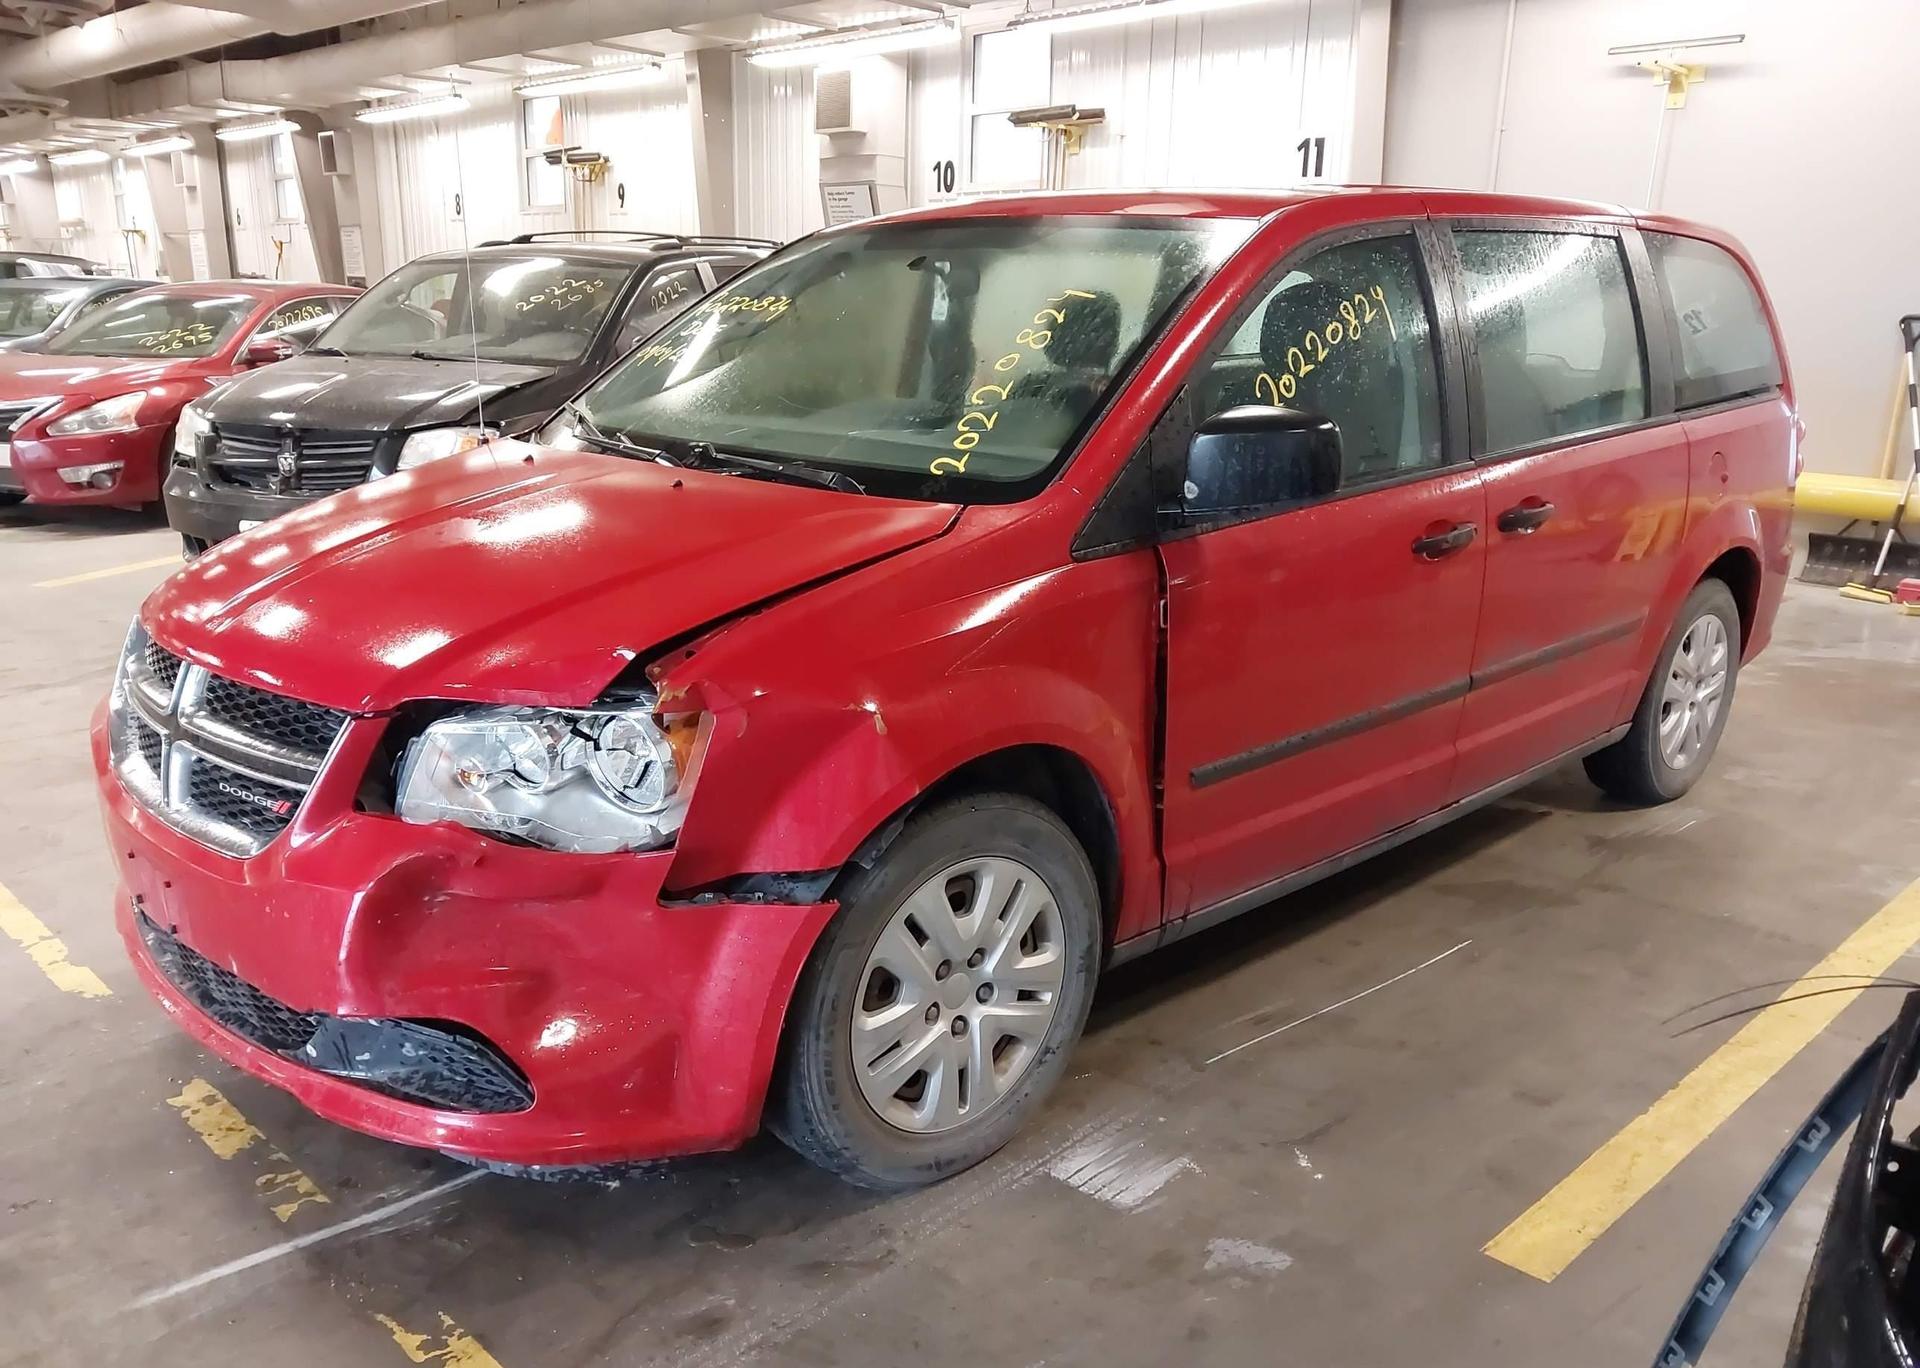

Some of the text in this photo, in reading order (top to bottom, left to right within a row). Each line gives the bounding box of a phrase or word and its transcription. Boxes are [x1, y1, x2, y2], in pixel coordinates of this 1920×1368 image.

[1297, 137, 1325, 177] 11
[933, 160, 955, 193] 10
[455, 193, 461, 215] 8
[618, 183, 625, 208] 9
[236, 208, 242, 226] 6
[516, 279, 587, 312] 2022
[651, 281, 688, 312] 2022
[139, 323, 215, 345] 2022
[152, 333, 213, 353] 2695
[1256, 285, 1397, 407] 20220824
[930, 289, 1097, 476] 20220824
[219, 783, 278, 808] DODGE
